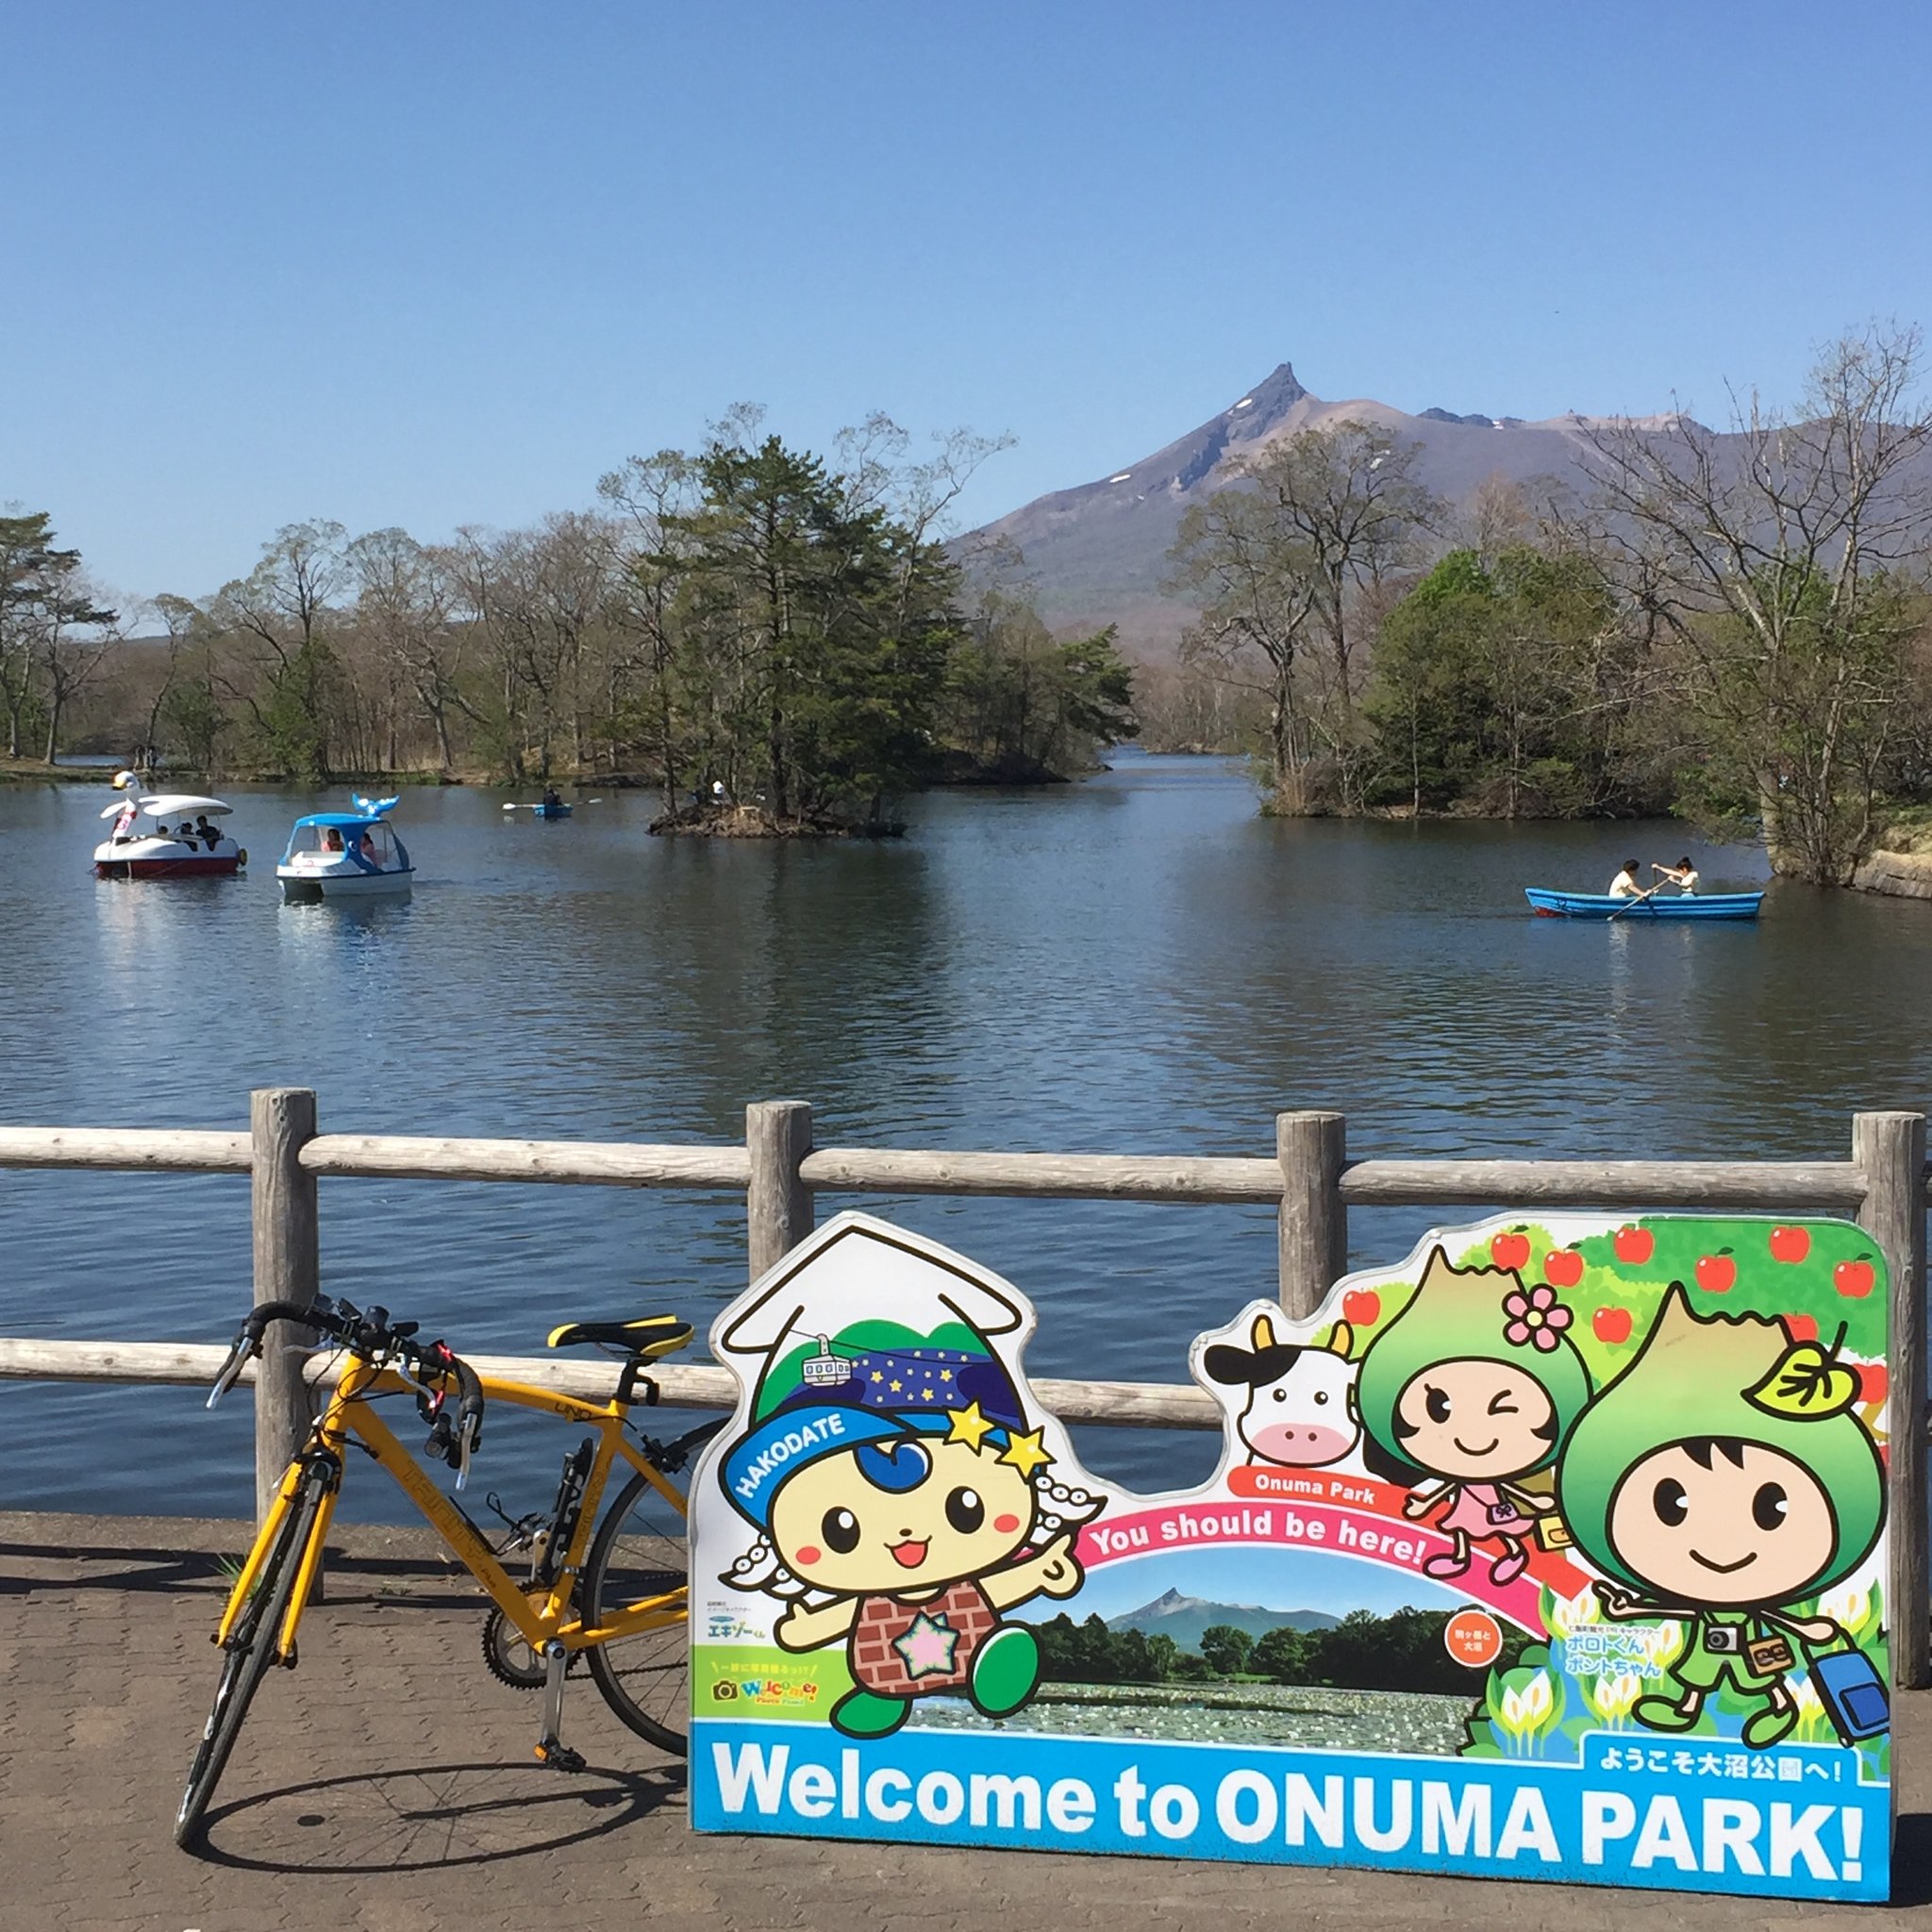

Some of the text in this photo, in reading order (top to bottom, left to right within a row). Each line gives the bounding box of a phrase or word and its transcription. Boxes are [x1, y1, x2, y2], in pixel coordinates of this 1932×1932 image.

[735, 1412, 845, 1499] HAKODATE
[1255, 1474, 1375, 1506] Onuma Park
[1088, 1509, 1427, 1566] You should be here!
[1568, 1636, 1645, 1655] ポロトくん
[1568, 1657, 1661, 1677] ポントちゃん
[711, 1742, 1864, 1882] Welcome to ONUMA PARK!
